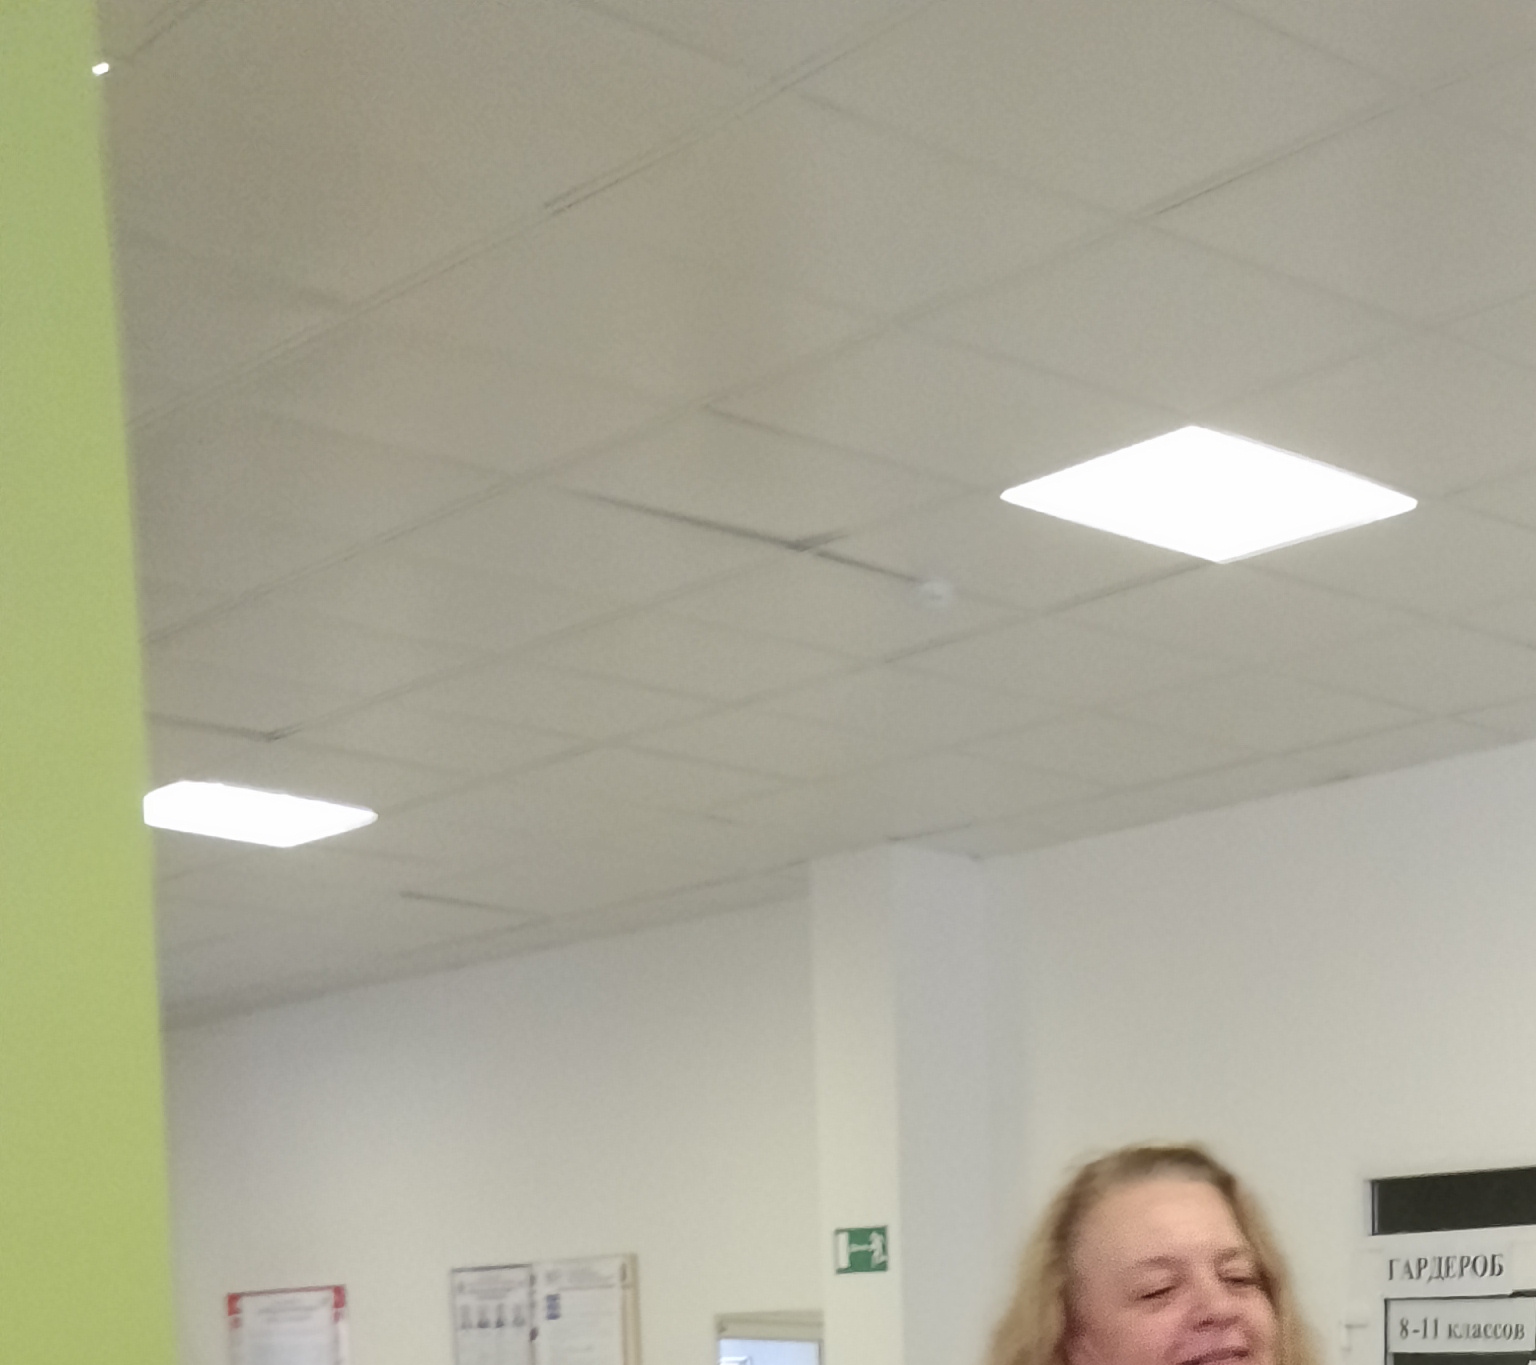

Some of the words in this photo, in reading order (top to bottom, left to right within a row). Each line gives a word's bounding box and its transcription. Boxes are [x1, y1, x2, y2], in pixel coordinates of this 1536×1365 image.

[1388, 1254, 1504, 1283] ГАРДЕРОБ
[1400, 1317, 1439, 1340] 8-11
[1447, 1322, 1525, 1341] классов
